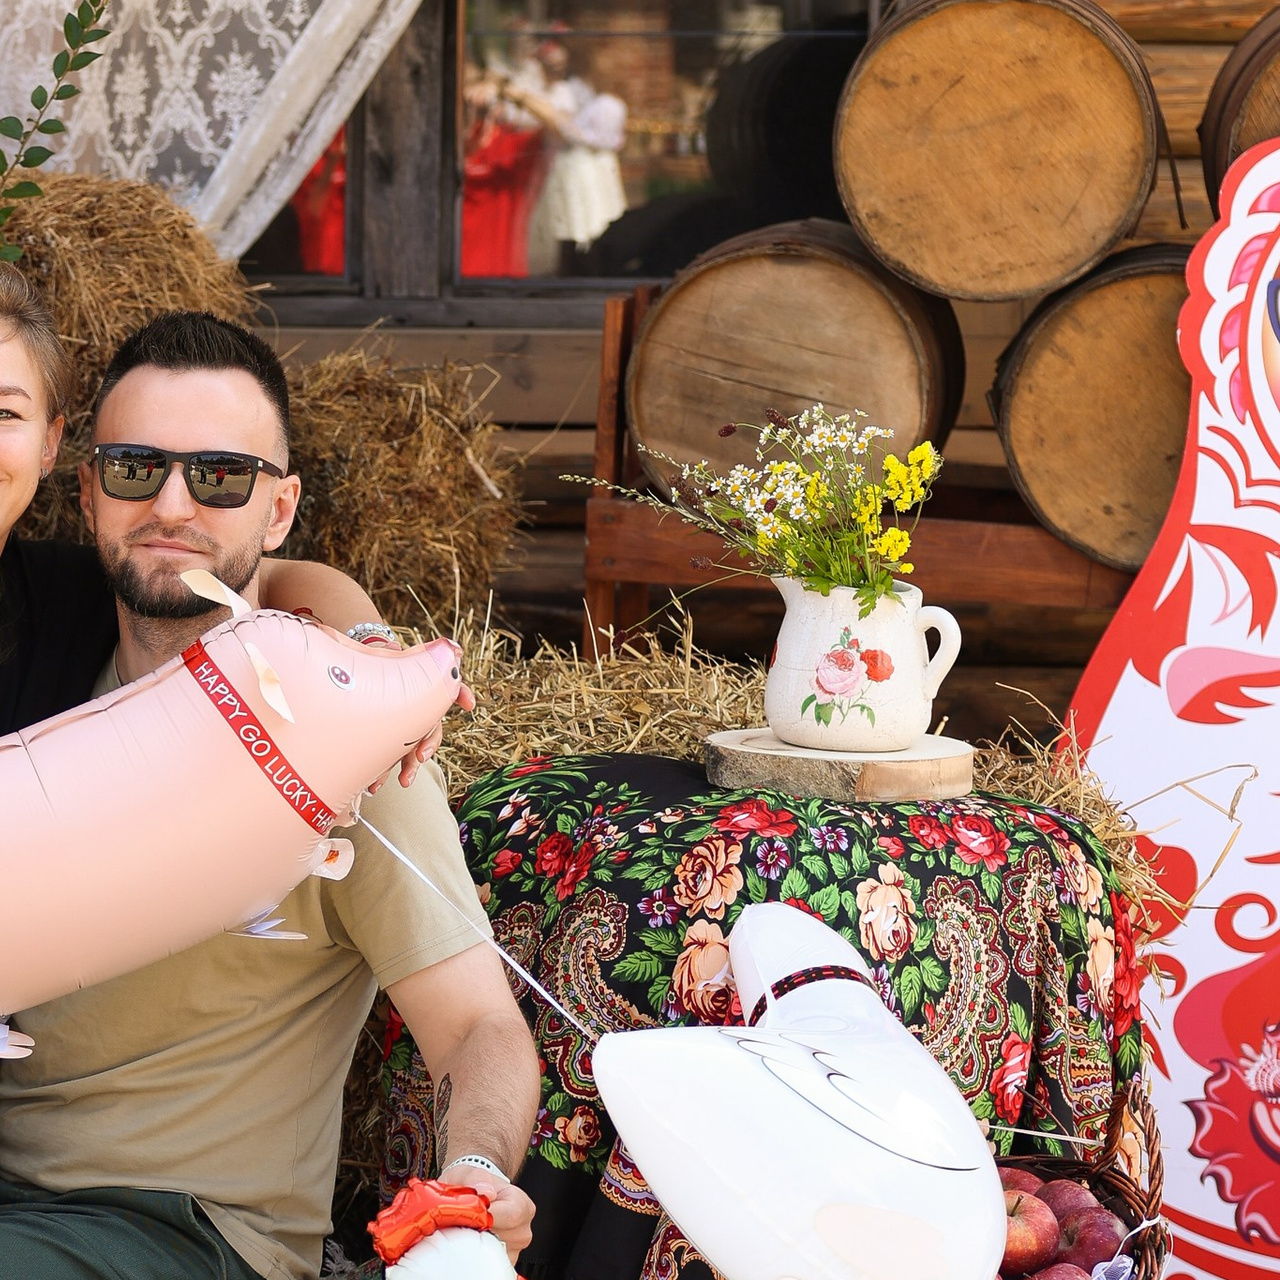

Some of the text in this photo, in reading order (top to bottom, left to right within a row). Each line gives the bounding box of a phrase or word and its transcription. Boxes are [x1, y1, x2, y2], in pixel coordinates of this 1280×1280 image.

[194, 661, 248, 720] HAPPY
[239, 724, 271, 757] GO
[264, 755, 317, 811] LUCKY
